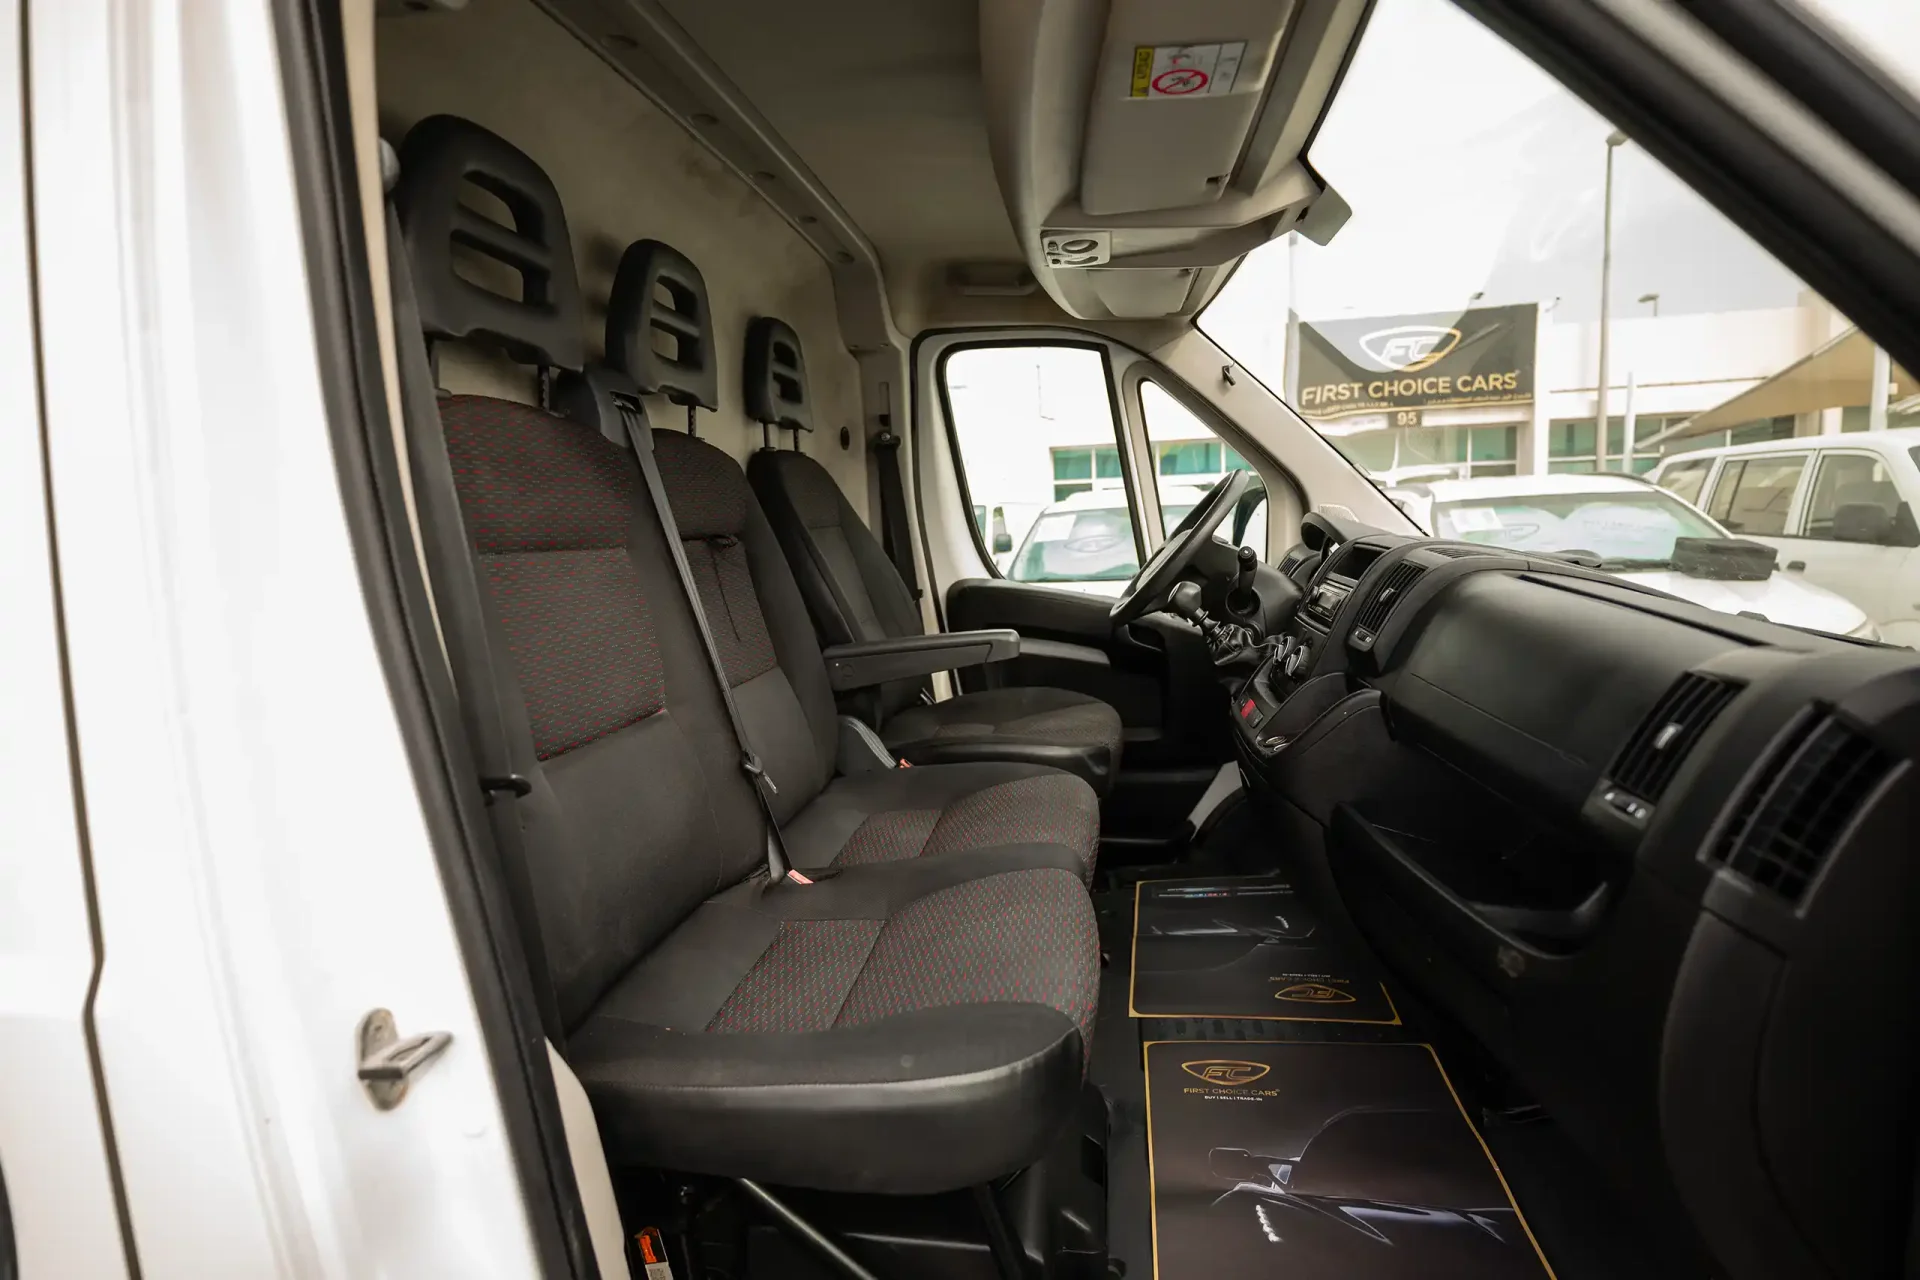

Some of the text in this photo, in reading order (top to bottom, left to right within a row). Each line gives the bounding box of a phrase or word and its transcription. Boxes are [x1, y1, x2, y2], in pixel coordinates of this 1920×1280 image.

[1301, 383, 1363, 405] FIRST
[1368, 377, 1451, 399] CHOICE
[1456, 372, 1518, 392] CARS
[1396, 411, 1418, 426] 95
[1250, 1089, 1278, 1097] CARS
